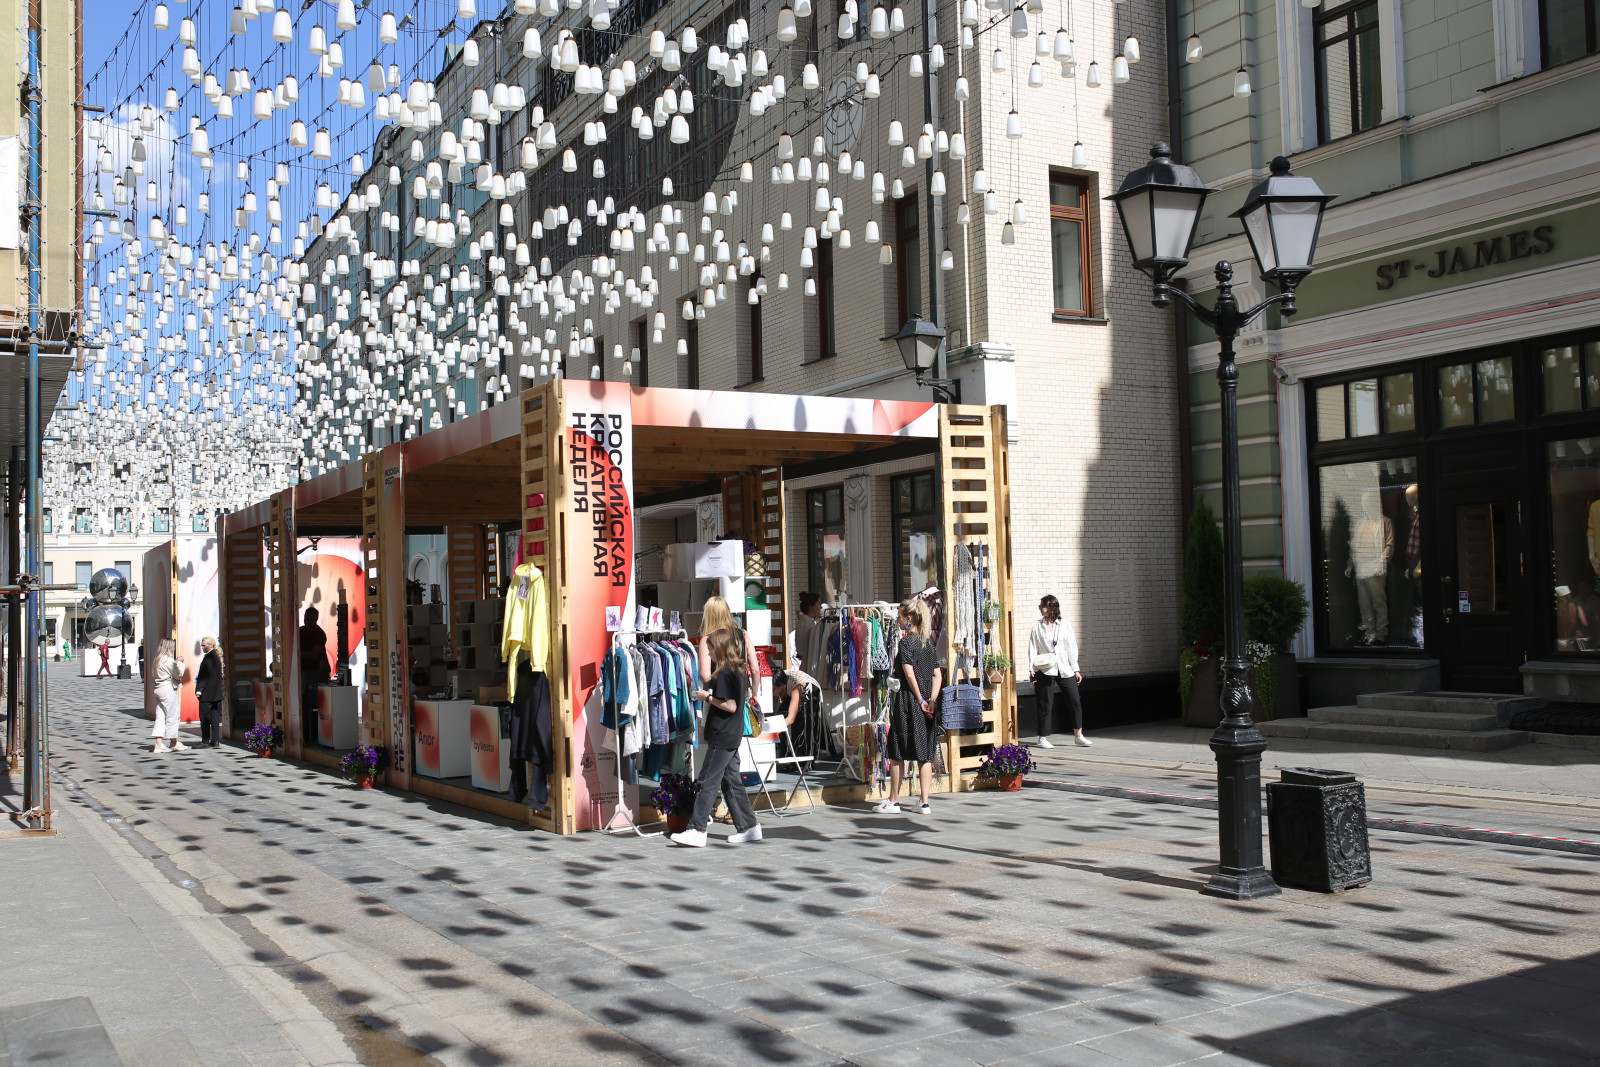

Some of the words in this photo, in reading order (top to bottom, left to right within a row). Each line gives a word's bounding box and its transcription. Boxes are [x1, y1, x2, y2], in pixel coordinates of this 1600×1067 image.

[570, 412, 589, 513] НЕДЕЛЯ
[590, 413, 608, 577] КРЕАТИВНАЯ
[608, 414, 629, 587] РОССИЙСКАЯ
[390, 651, 399, 771] МОДНЫЙ
[395, 633, 405, 773] ПРОСПЕКТ
[418, 730, 435, 746] Anor
